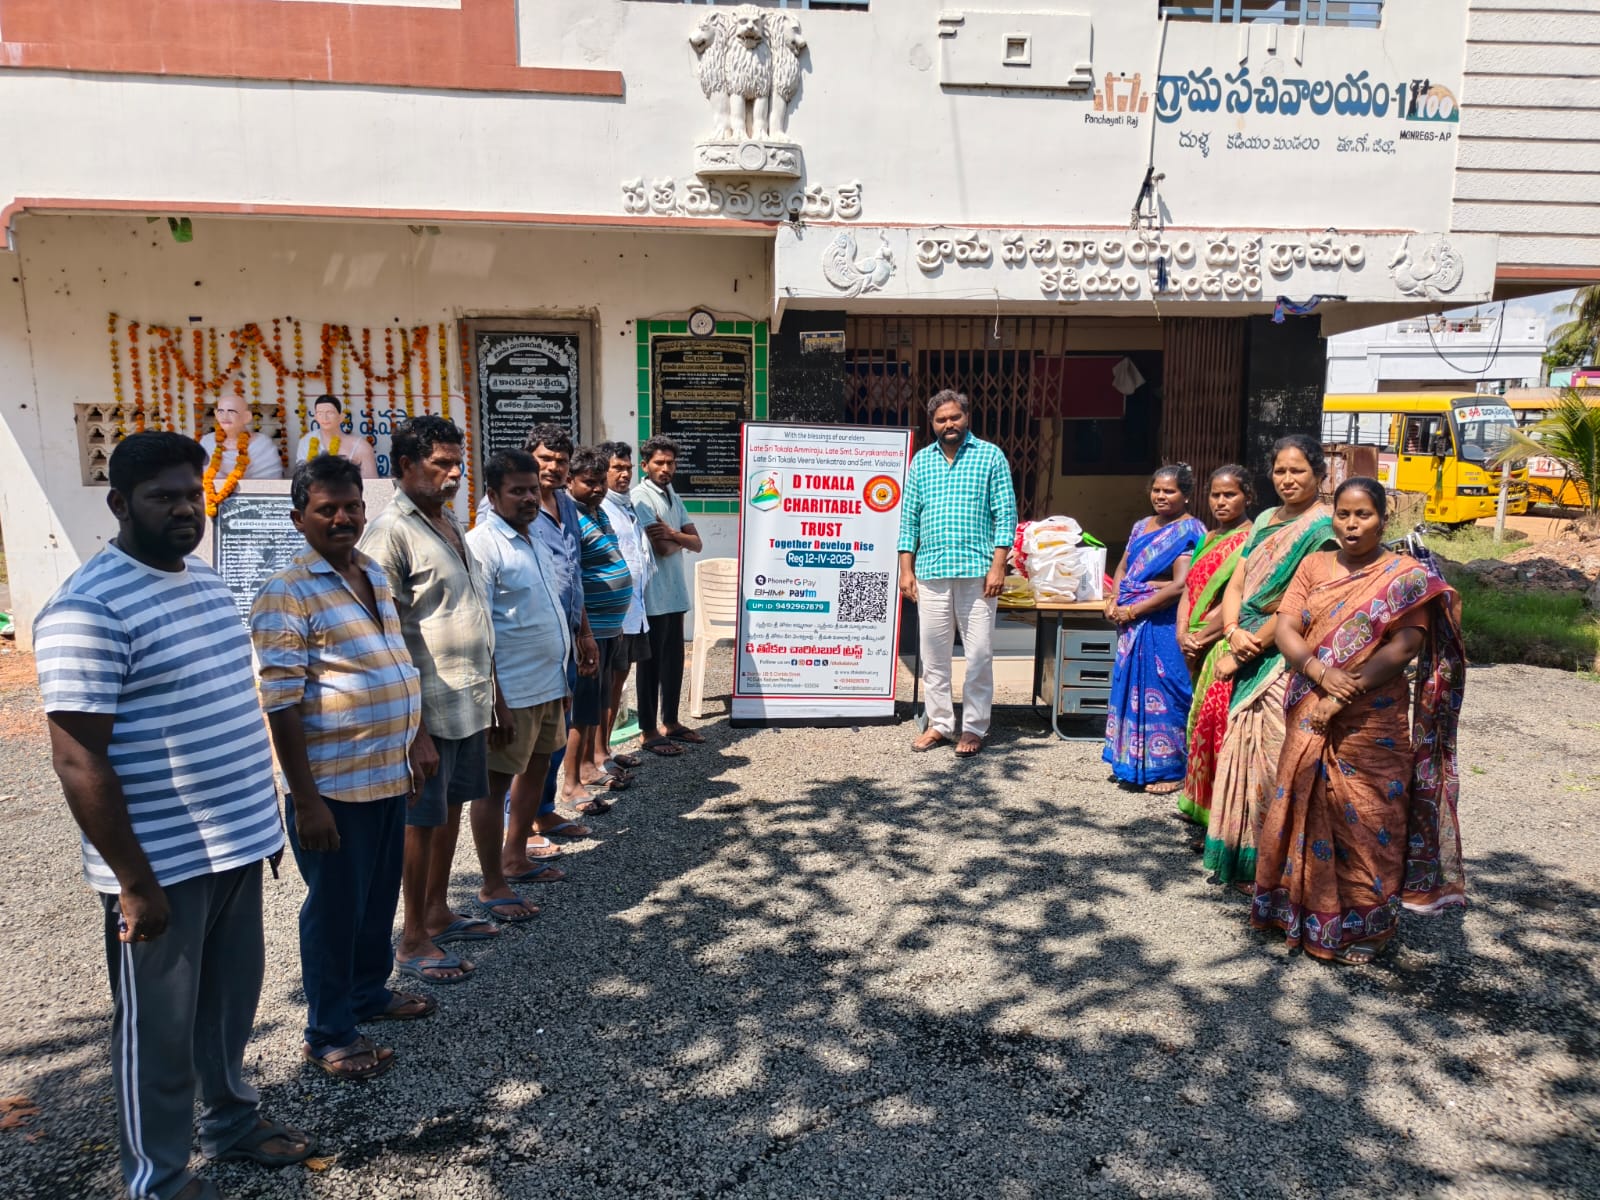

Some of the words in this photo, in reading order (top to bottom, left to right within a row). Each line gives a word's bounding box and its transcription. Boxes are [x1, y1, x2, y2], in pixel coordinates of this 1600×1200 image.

[1084, 113, 1124, 127] Panchayati
[1126, 115, 1139, 128] Raj
[1226, 132, 1270, 151] కడియం
[1399, 130, 1452, 142] MGNREGS-AP
[916, 231, 993, 272] గ్రామ
[1039, 267, 1140, 294] కడియం
[784, 431, 798, 439] With
[807, 432, 832, 442] blessings
[848, 434, 865, 442] elders
[774, 445, 793, 453] Tokala
[825, 447, 839, 455] Late
[854, 448, 899, 458] Suryakantham
[753, 455, 767, 463] Late
[777, 456, 796, 464] Tokala
[797, 456, 816, 464] Veera
[847, 458, 859, 466] and
[792, 474, 802, 488] D
[805, 475, 855, 491] TOKALA
[783, 498, 862, 514] CHARITABLE
[800, 522, 842, 537] TRUST
[769, 538, 812, 550] Together
[814, 540, 850, 552] Develop
[854, 541, 874, 552] Rise
[788, 553, 804, 566] Reg
[805, 554, 853, 565] 12-IV-2025
[768, 577, 794, 585] PhonePe
[802, 578, 816, 588] Pay
[754, 588, 781, 596] BHIM
[757, 642, 787, 654] తోకల
